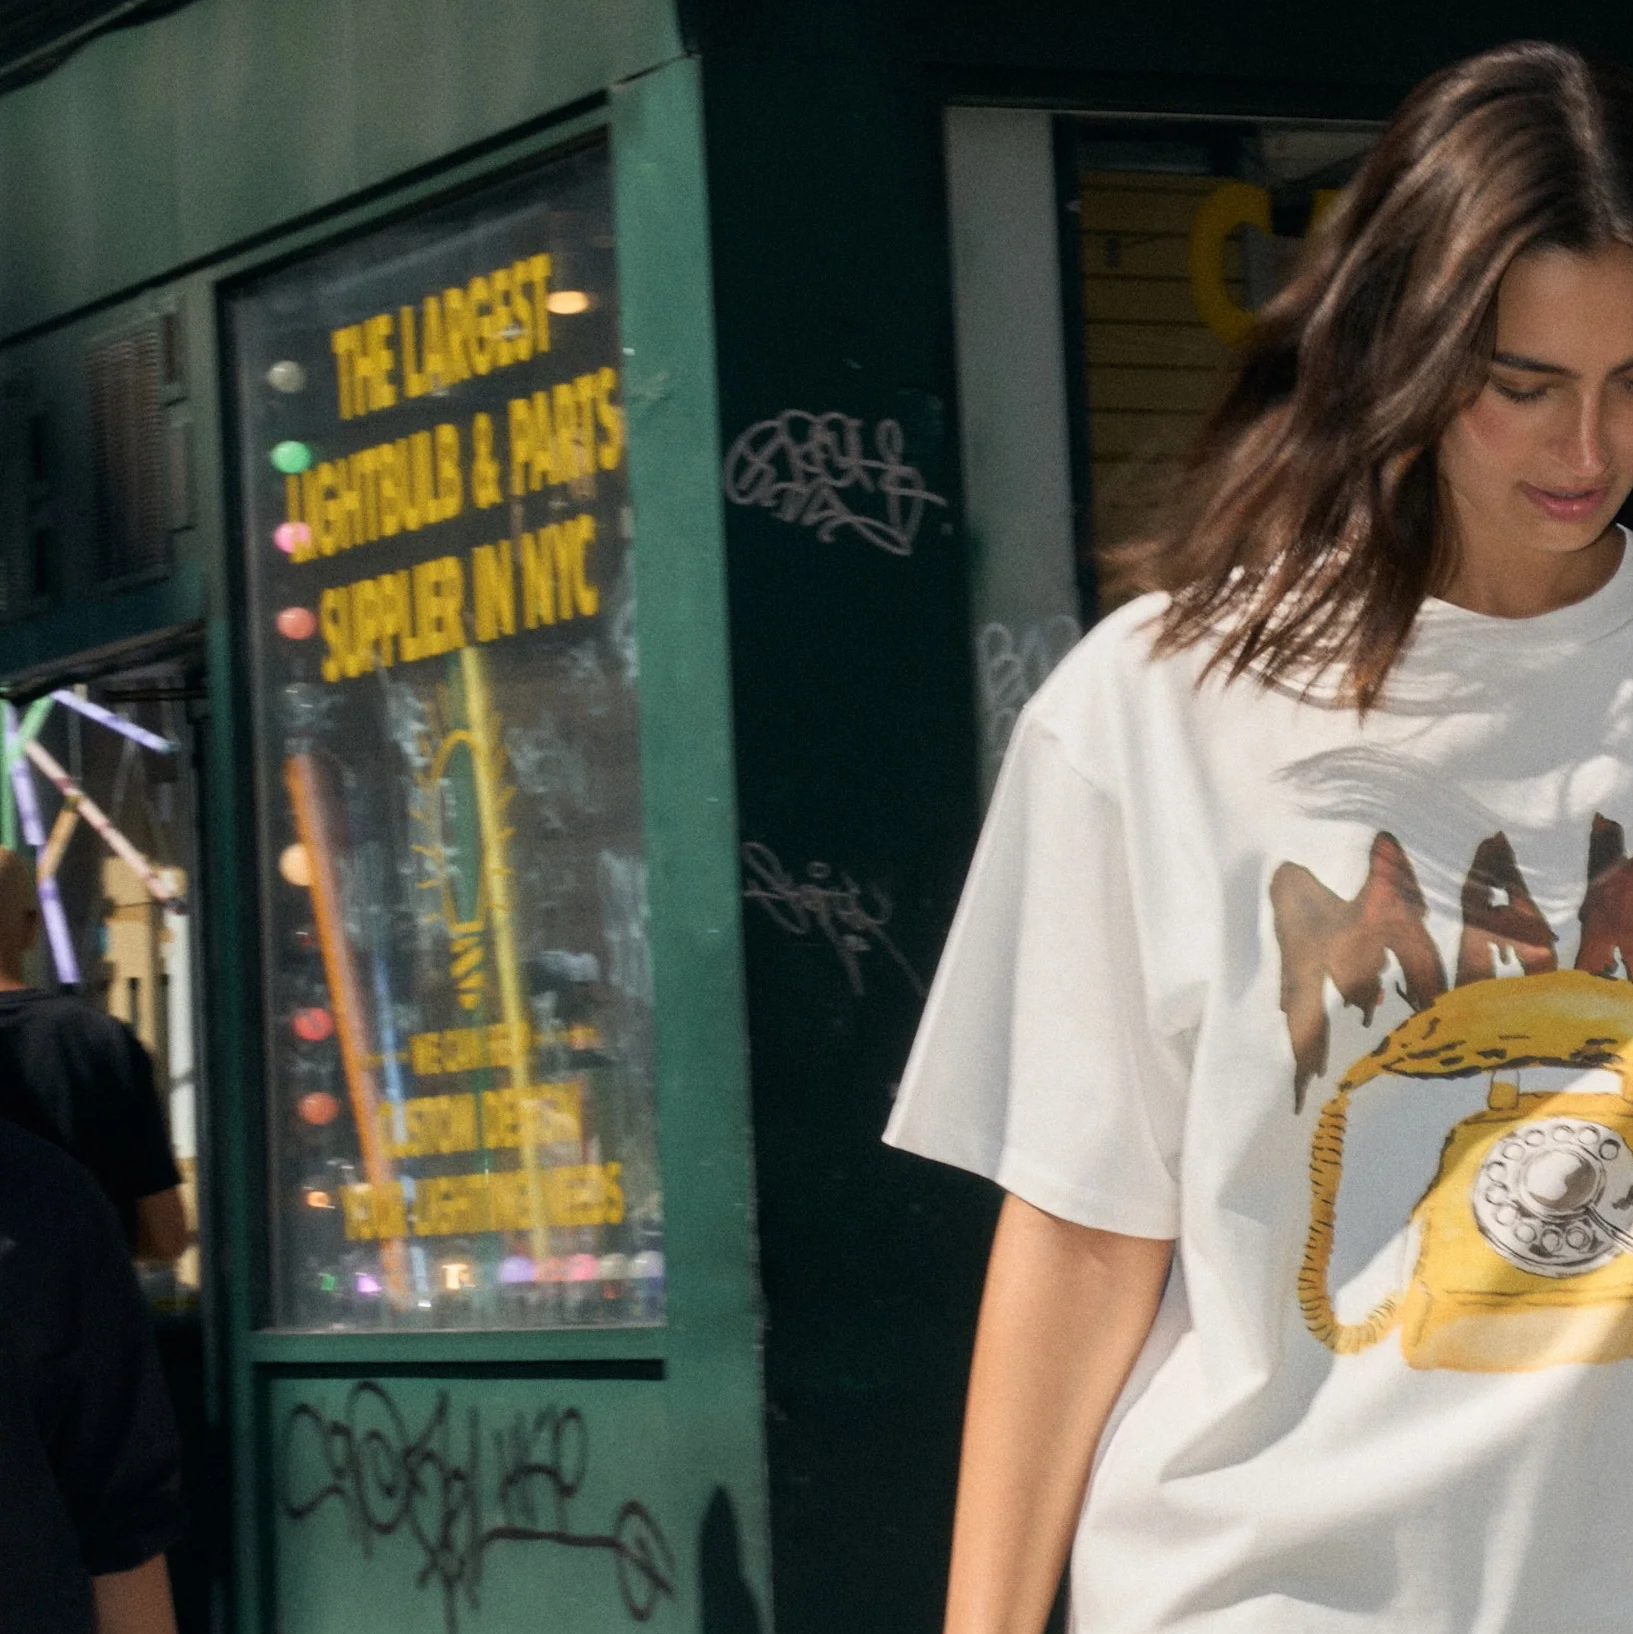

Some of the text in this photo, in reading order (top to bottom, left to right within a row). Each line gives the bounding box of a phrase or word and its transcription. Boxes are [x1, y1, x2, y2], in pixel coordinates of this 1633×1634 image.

[331, 253, 553, 420] THE LARGEST
[286, 423, 464, 564] LIGHTBULB
[472, 412, 504, 509] &
[507, 366, 627, 497] PARTS
[320, 514, 599, 683] SUPPLIER IN NYC
